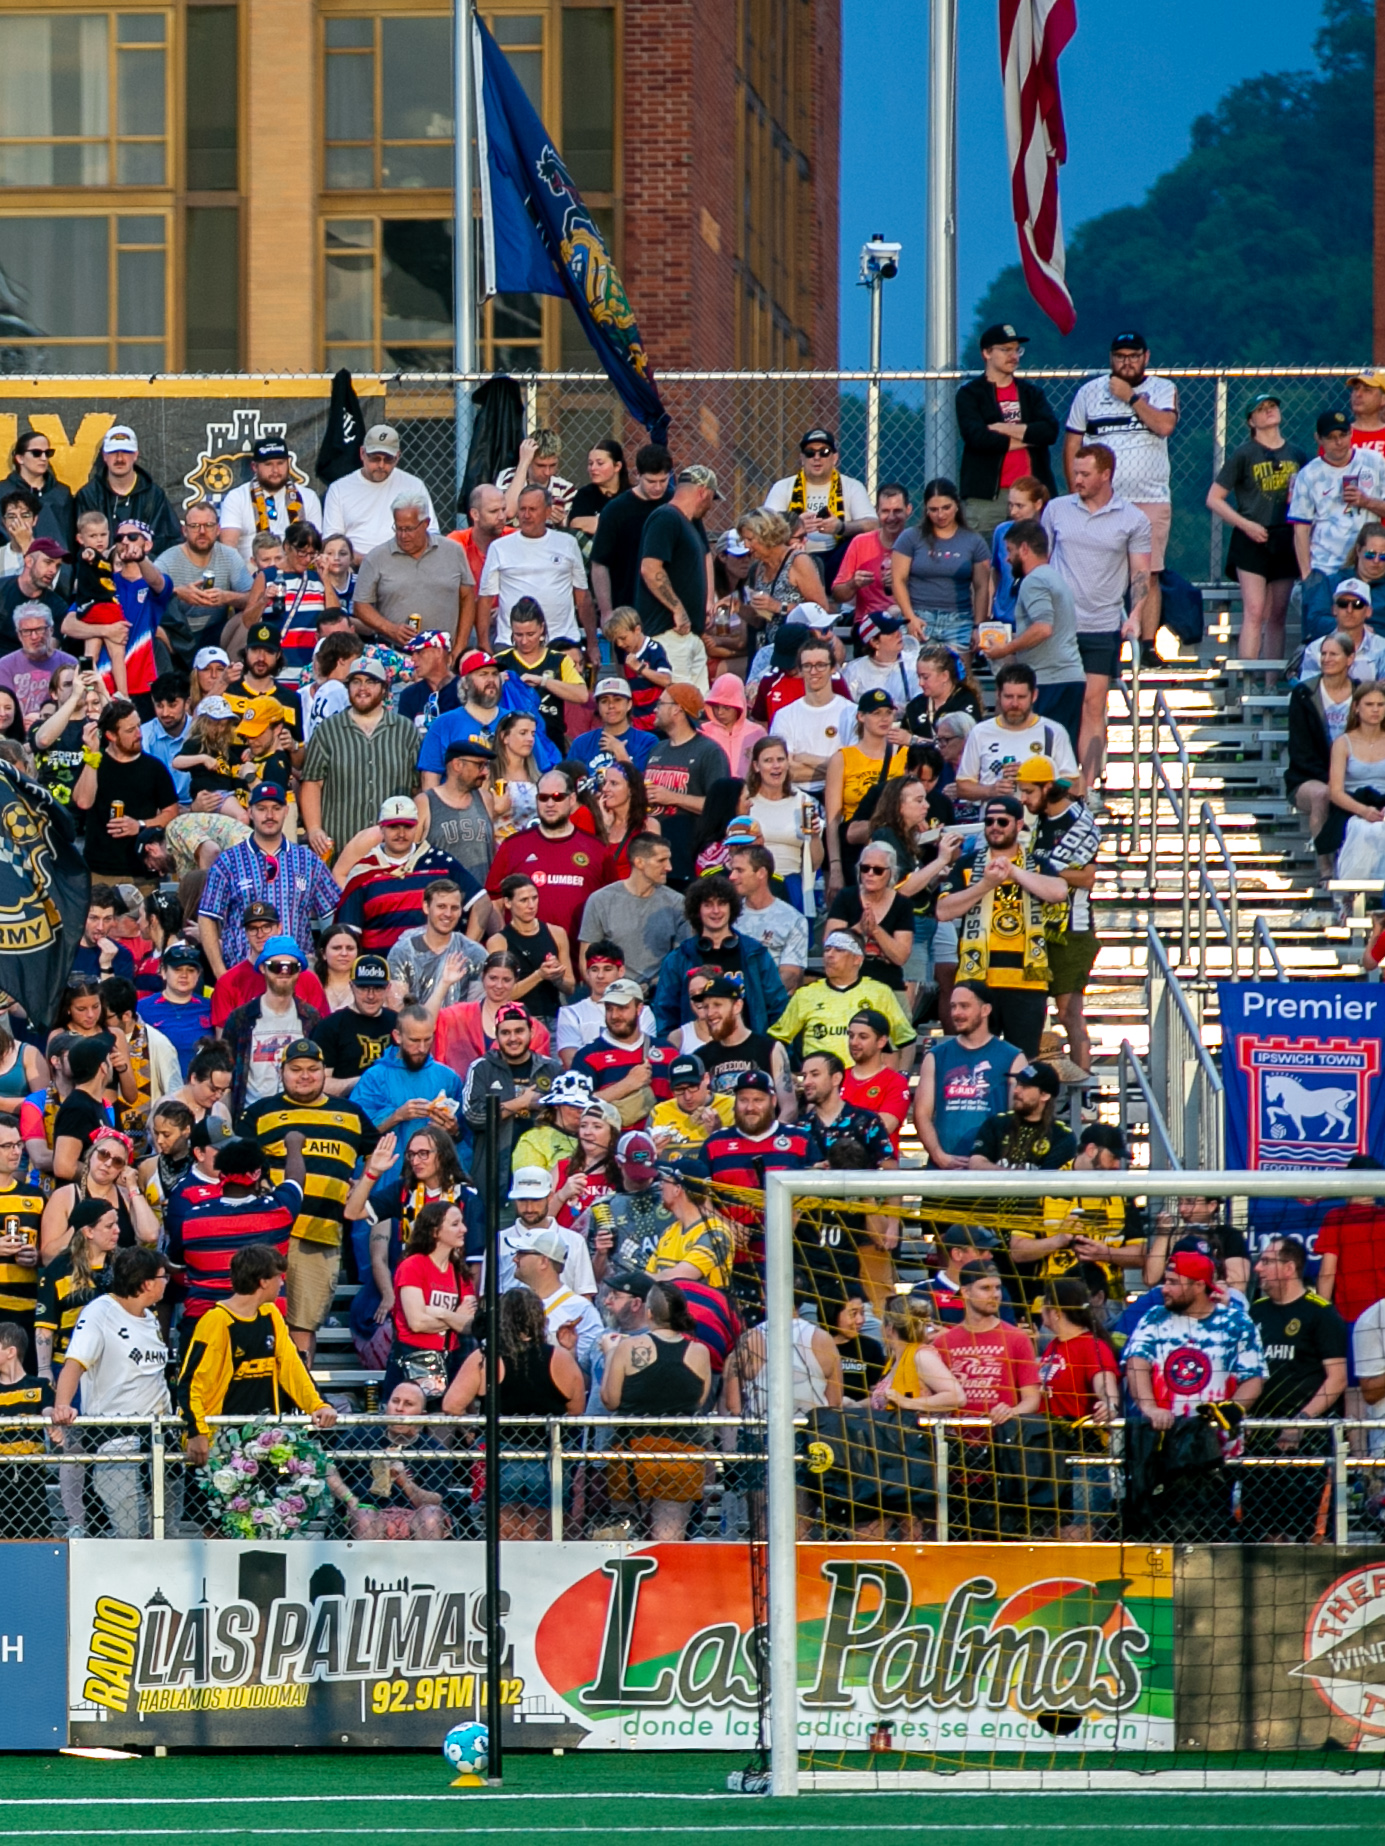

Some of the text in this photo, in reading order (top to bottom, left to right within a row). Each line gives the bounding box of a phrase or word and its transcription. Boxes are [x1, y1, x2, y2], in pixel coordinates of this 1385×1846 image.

[441, 818, 490, 845] USA
[547, 874, 584, 887] LUMBER
[358, 965, 385, 977] Modelo
[1243, 991, 1378, 1021] Premier
[714, 1060, 752, 1075] FREEDOM
[1258, 1052, 1362, 1067] IPSWICH TOWN
[311, 1141, 341, 1156] AHN
[432, 1292, 460, 1312] USA
[145, 1350, 167, 1364] AHN
[1264, 1344, 1295, 1360] AHN
[964, 1358, 1003, 1376] Pizza
[136, 1589, 512, 1690] LAS PALMAS
[579, 1556, 1149, 1711] Las Palmas
[82, 1595, 143, 1713] RADIO
[137, 1682, 308, 1712] HABLAMOS TU IDIOMA!
[371, 1675, 475, 1714] 92.9FM
[623, 1711, 1138, 1740] donde las adicines se encutran
